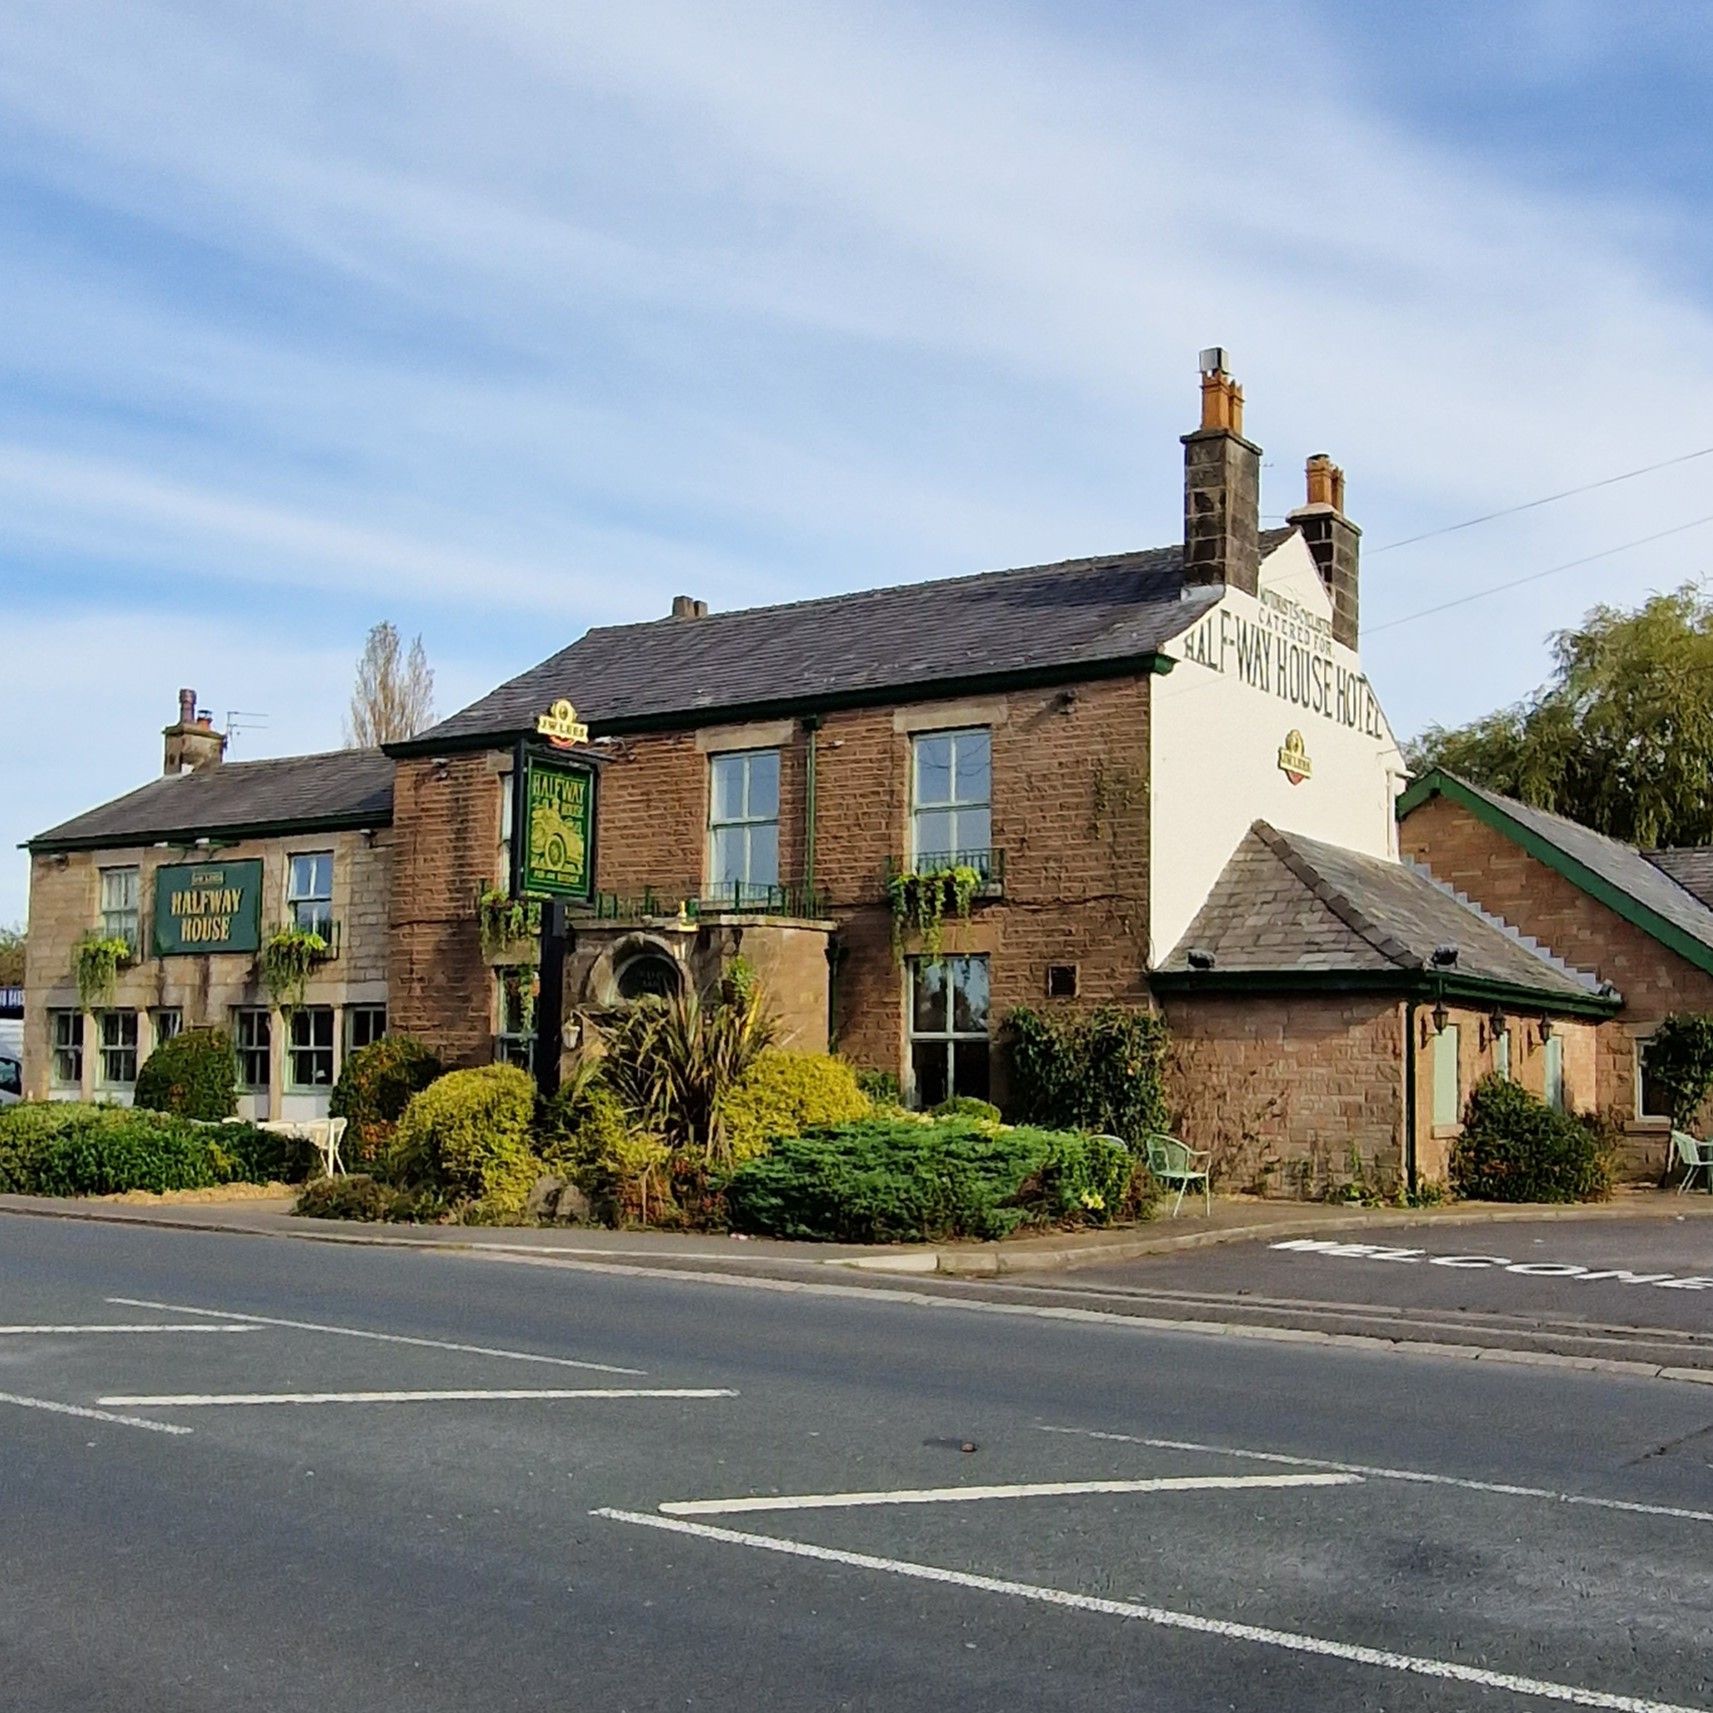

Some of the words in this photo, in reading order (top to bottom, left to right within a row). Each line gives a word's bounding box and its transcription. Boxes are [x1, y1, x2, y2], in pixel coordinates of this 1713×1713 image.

[1259, 607, 1310, 645] CATERED
[1277, 637, 1333, 719] HOUSE
[1337, 665, 1382, 739] HOTEL
[532, 774, 585, 804] HALFWAY
[171, 887, 242, 915] HALFWAY
[181, 915, 231, 941] HOUSE
